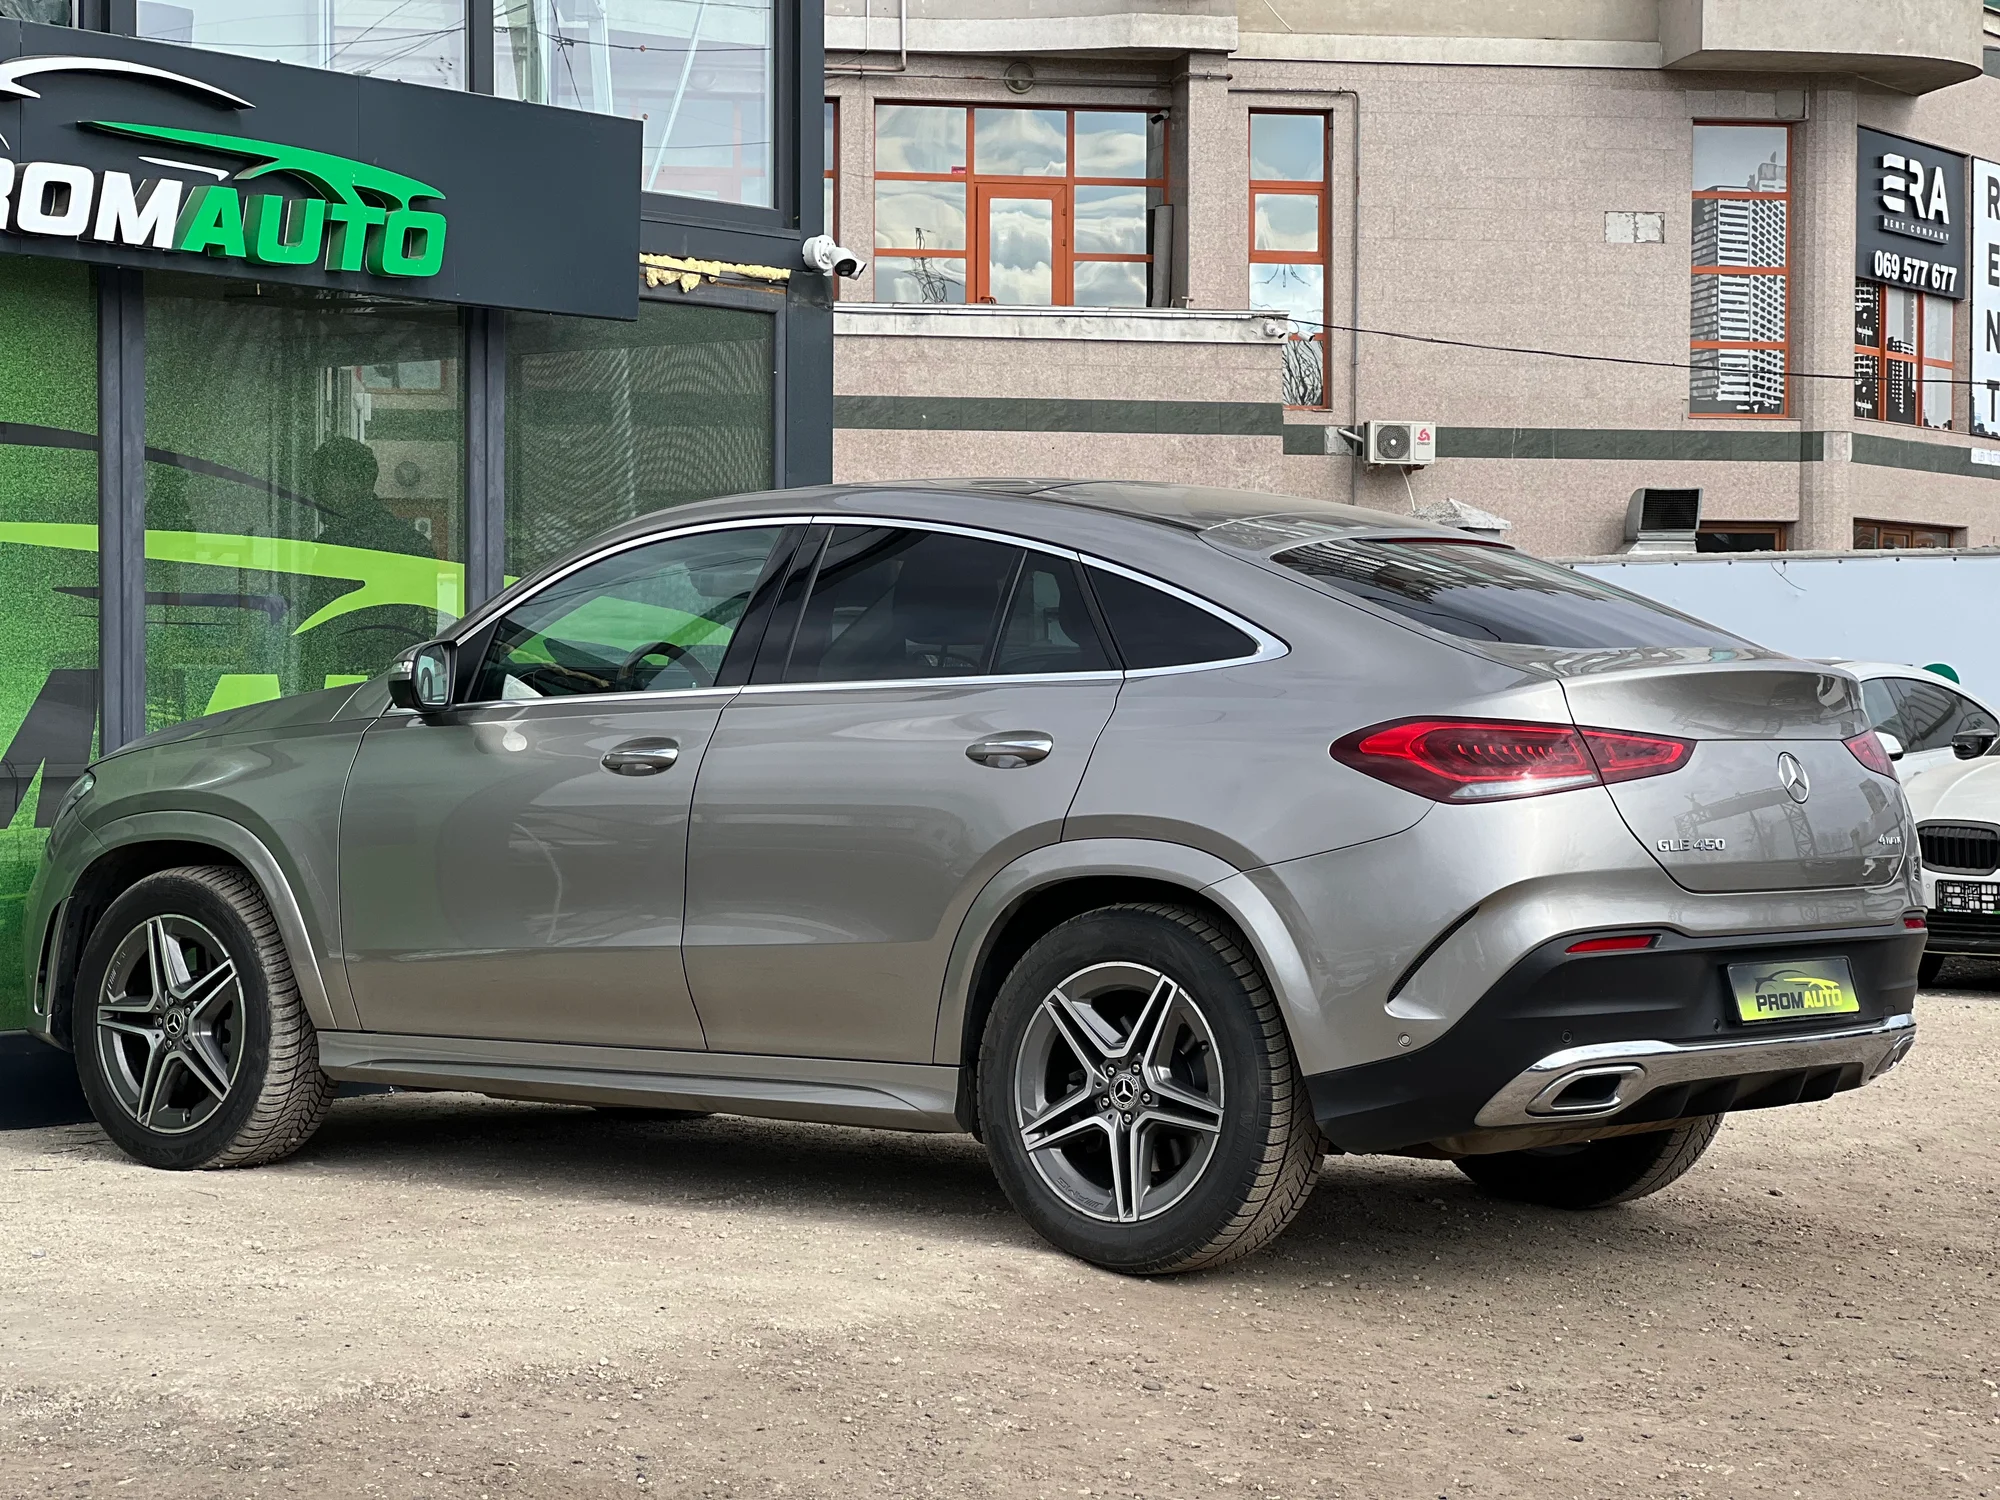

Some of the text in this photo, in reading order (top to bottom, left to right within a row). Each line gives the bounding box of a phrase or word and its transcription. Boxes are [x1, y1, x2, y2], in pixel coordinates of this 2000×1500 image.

[1883, 153, 1950, 225] ERA
[0, 157, 447, 277] OMAUTO
[1884, 217, 1950, 242] RENT COMPANY
[1874, 250, 1958, 292] 069 577 677
[1657, 838, 1727, 852] GLE 450
[1755, 988, 1843, 1013] PROMAUTO
